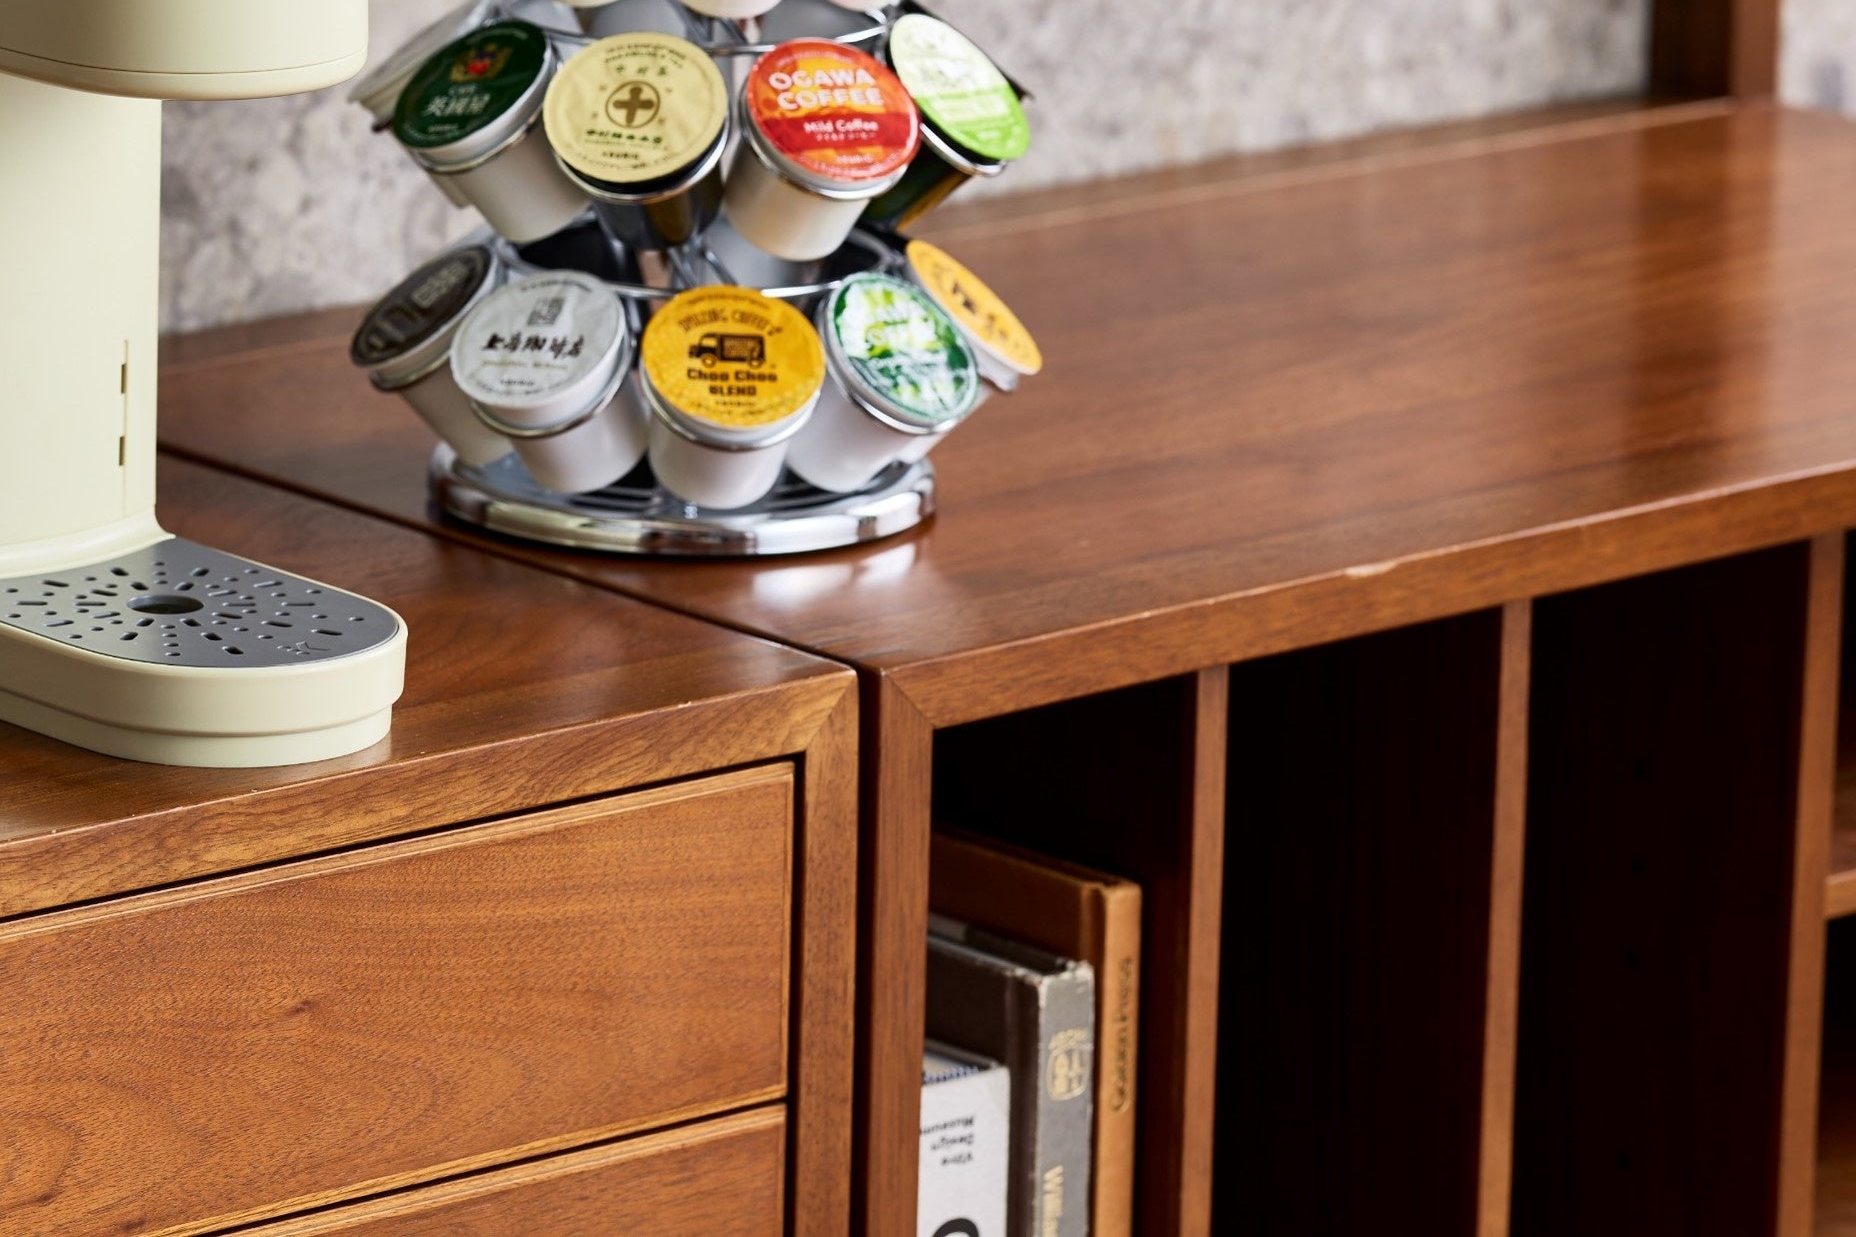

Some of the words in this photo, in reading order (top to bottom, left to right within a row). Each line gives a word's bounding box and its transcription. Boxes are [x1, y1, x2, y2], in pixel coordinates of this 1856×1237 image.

[768, 69, 877, 91] OGAWA
[777, 88, 885, 110] COFFEE
[803, 120, 834, 134] Mild
[835, 118, 879, 132] Coffee
[687, 368, 730, 382] Choo
[734, 369, 778, 383] Choo
[709, 385, 757, 396] BLEND
